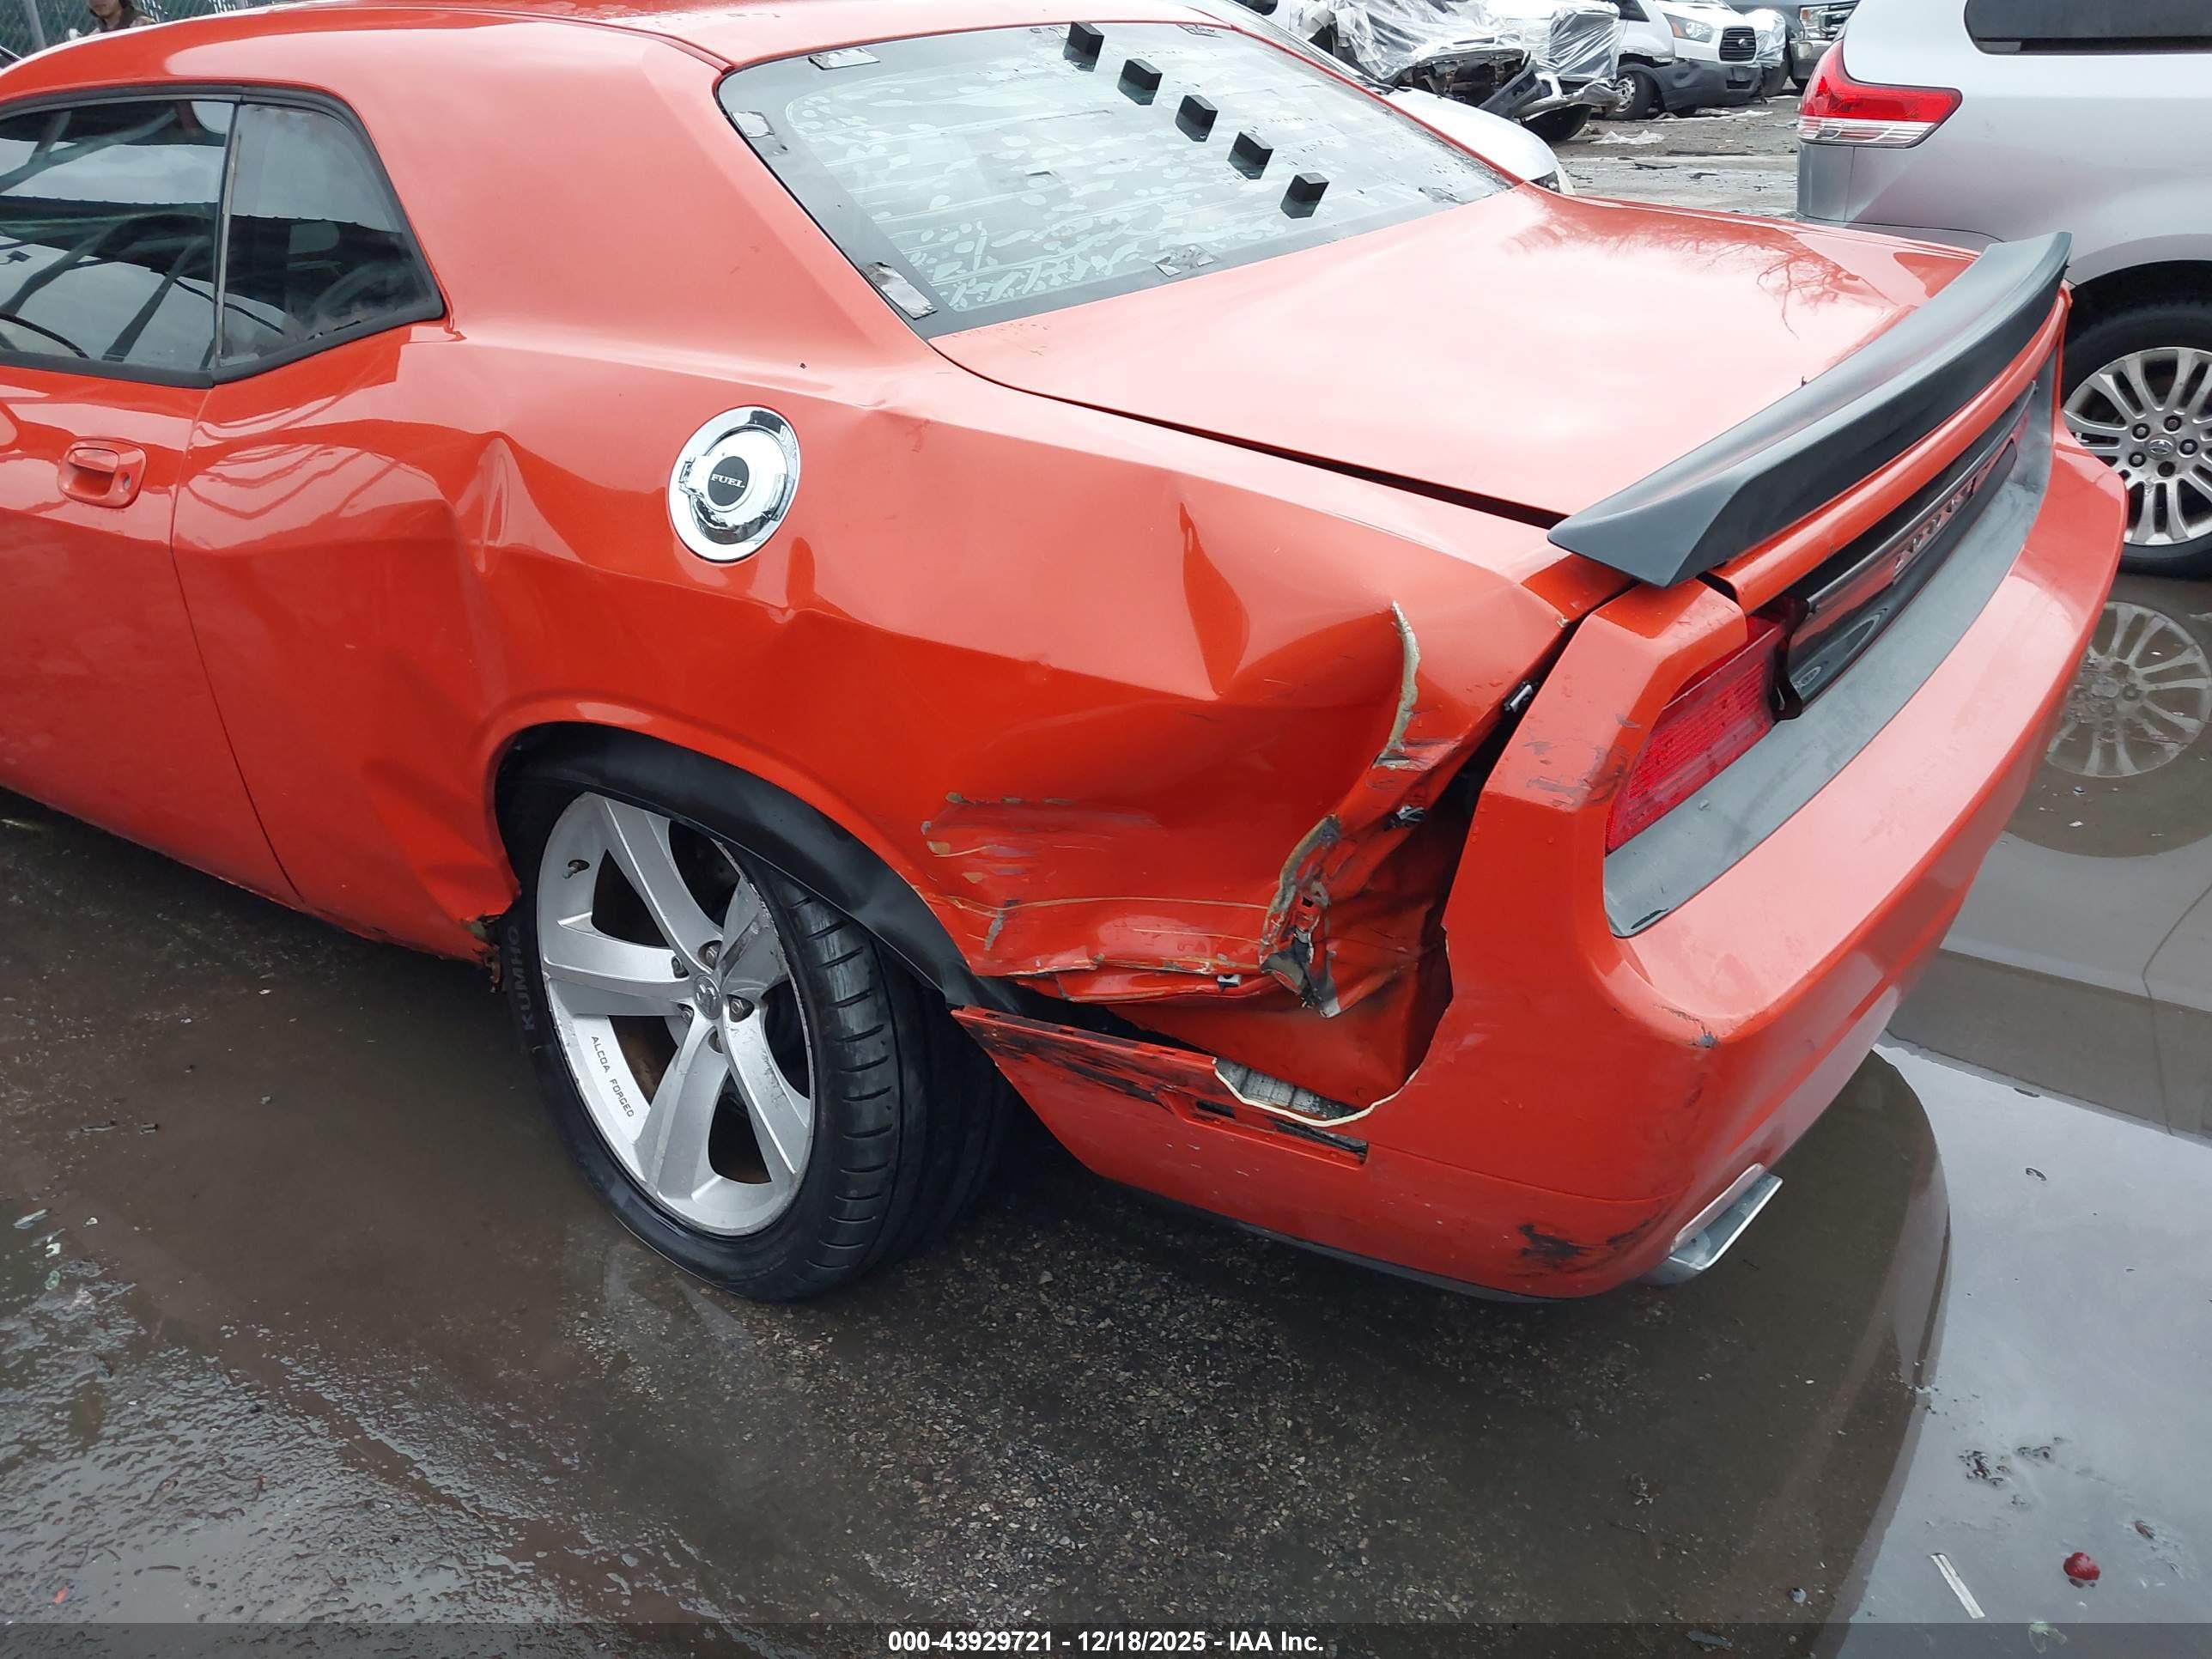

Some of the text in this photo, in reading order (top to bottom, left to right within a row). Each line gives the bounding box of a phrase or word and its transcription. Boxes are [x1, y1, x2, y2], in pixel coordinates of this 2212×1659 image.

[711, 474, 745, 488] FUEL
[507, 926, 535, 1030] KUMHO
[592, 1036, 634, 1117] ALCOA FORGED
